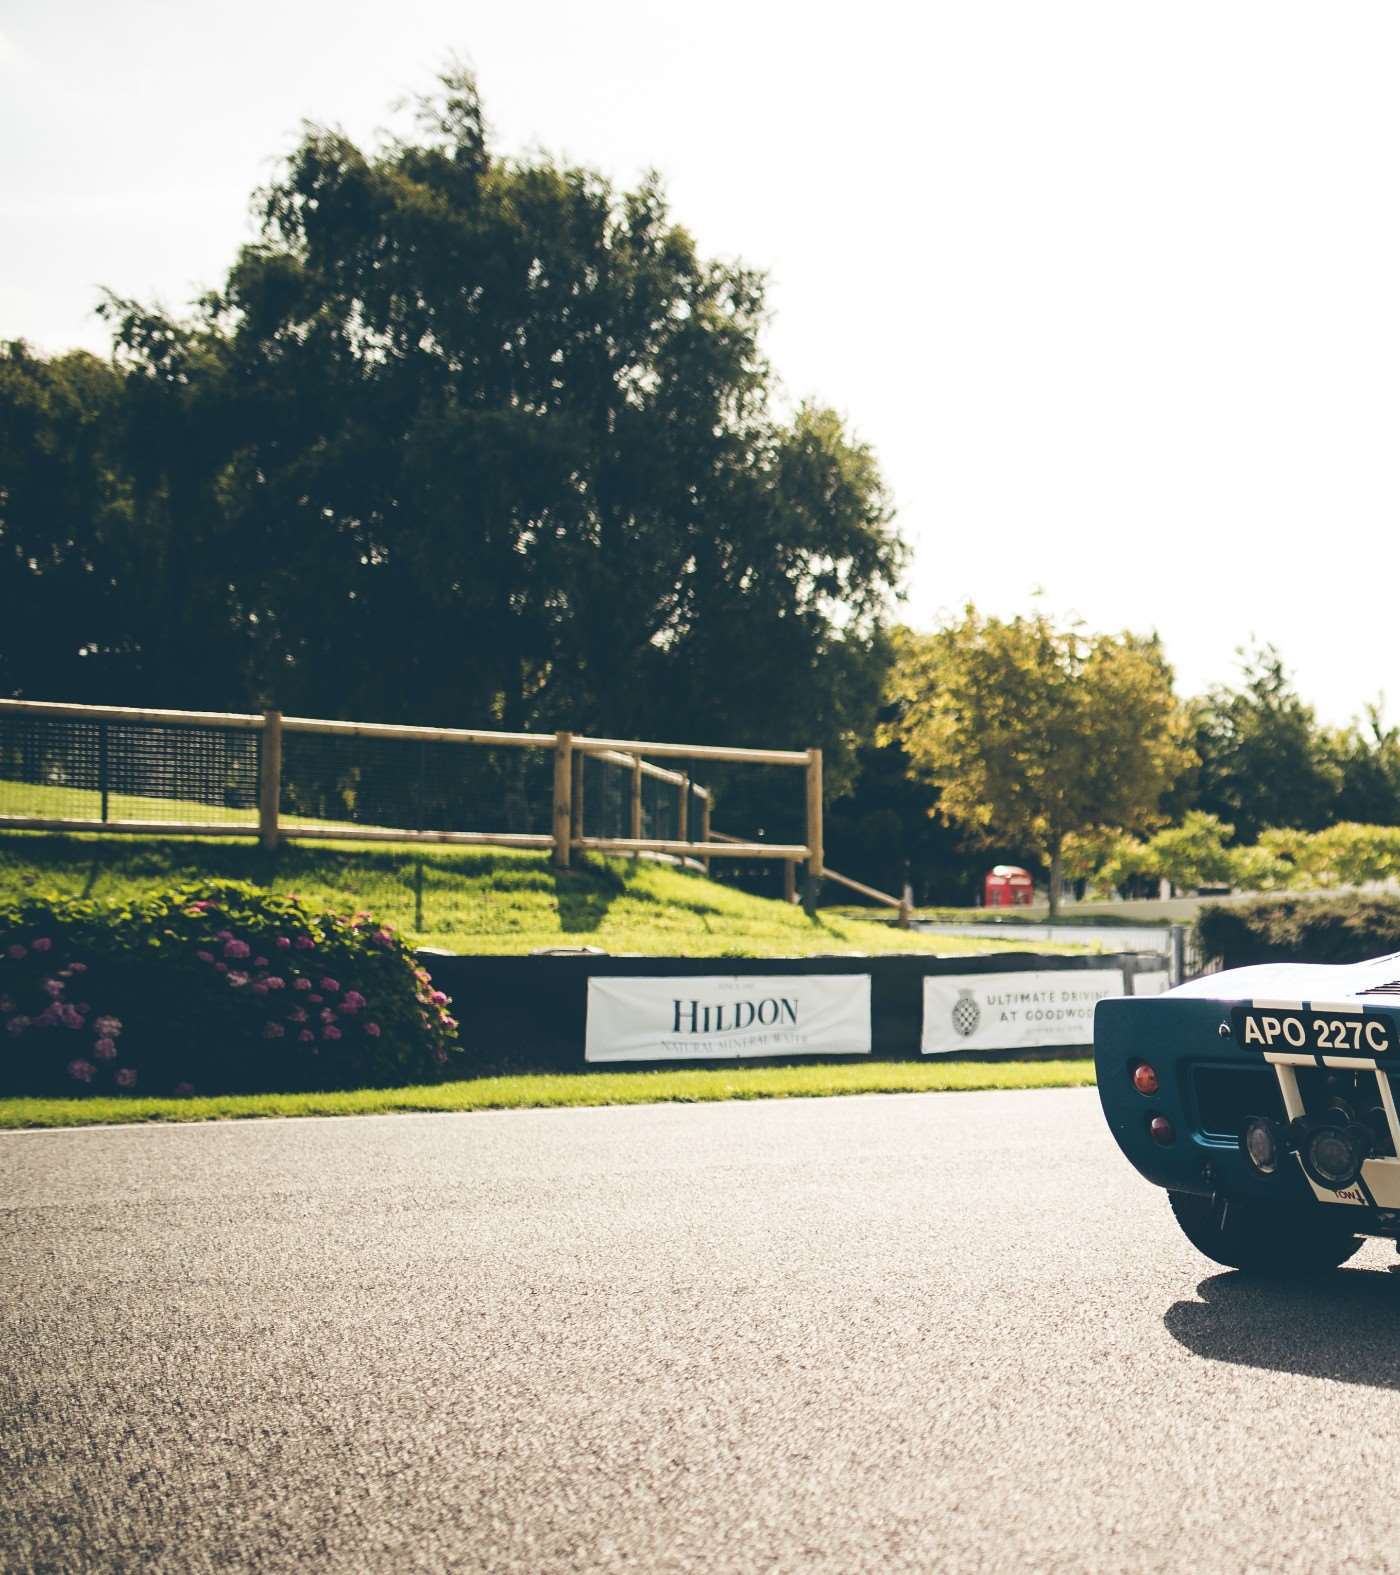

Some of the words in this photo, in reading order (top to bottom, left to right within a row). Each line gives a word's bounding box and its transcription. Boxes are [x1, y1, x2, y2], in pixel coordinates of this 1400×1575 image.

[987, 992, 1055, 1006] ULTIMATE
[672, 998, 799, 1033] HILDON
[1000, 1011, 1017, 1022] AT
[1025, 1009, 1093, 1021] GOODWOO
[1245, 1016, 1306, 1047] APO
[1313, 1019, 1389, 1052] 227C
[1334, 1189, 1356, 1200] TOW
